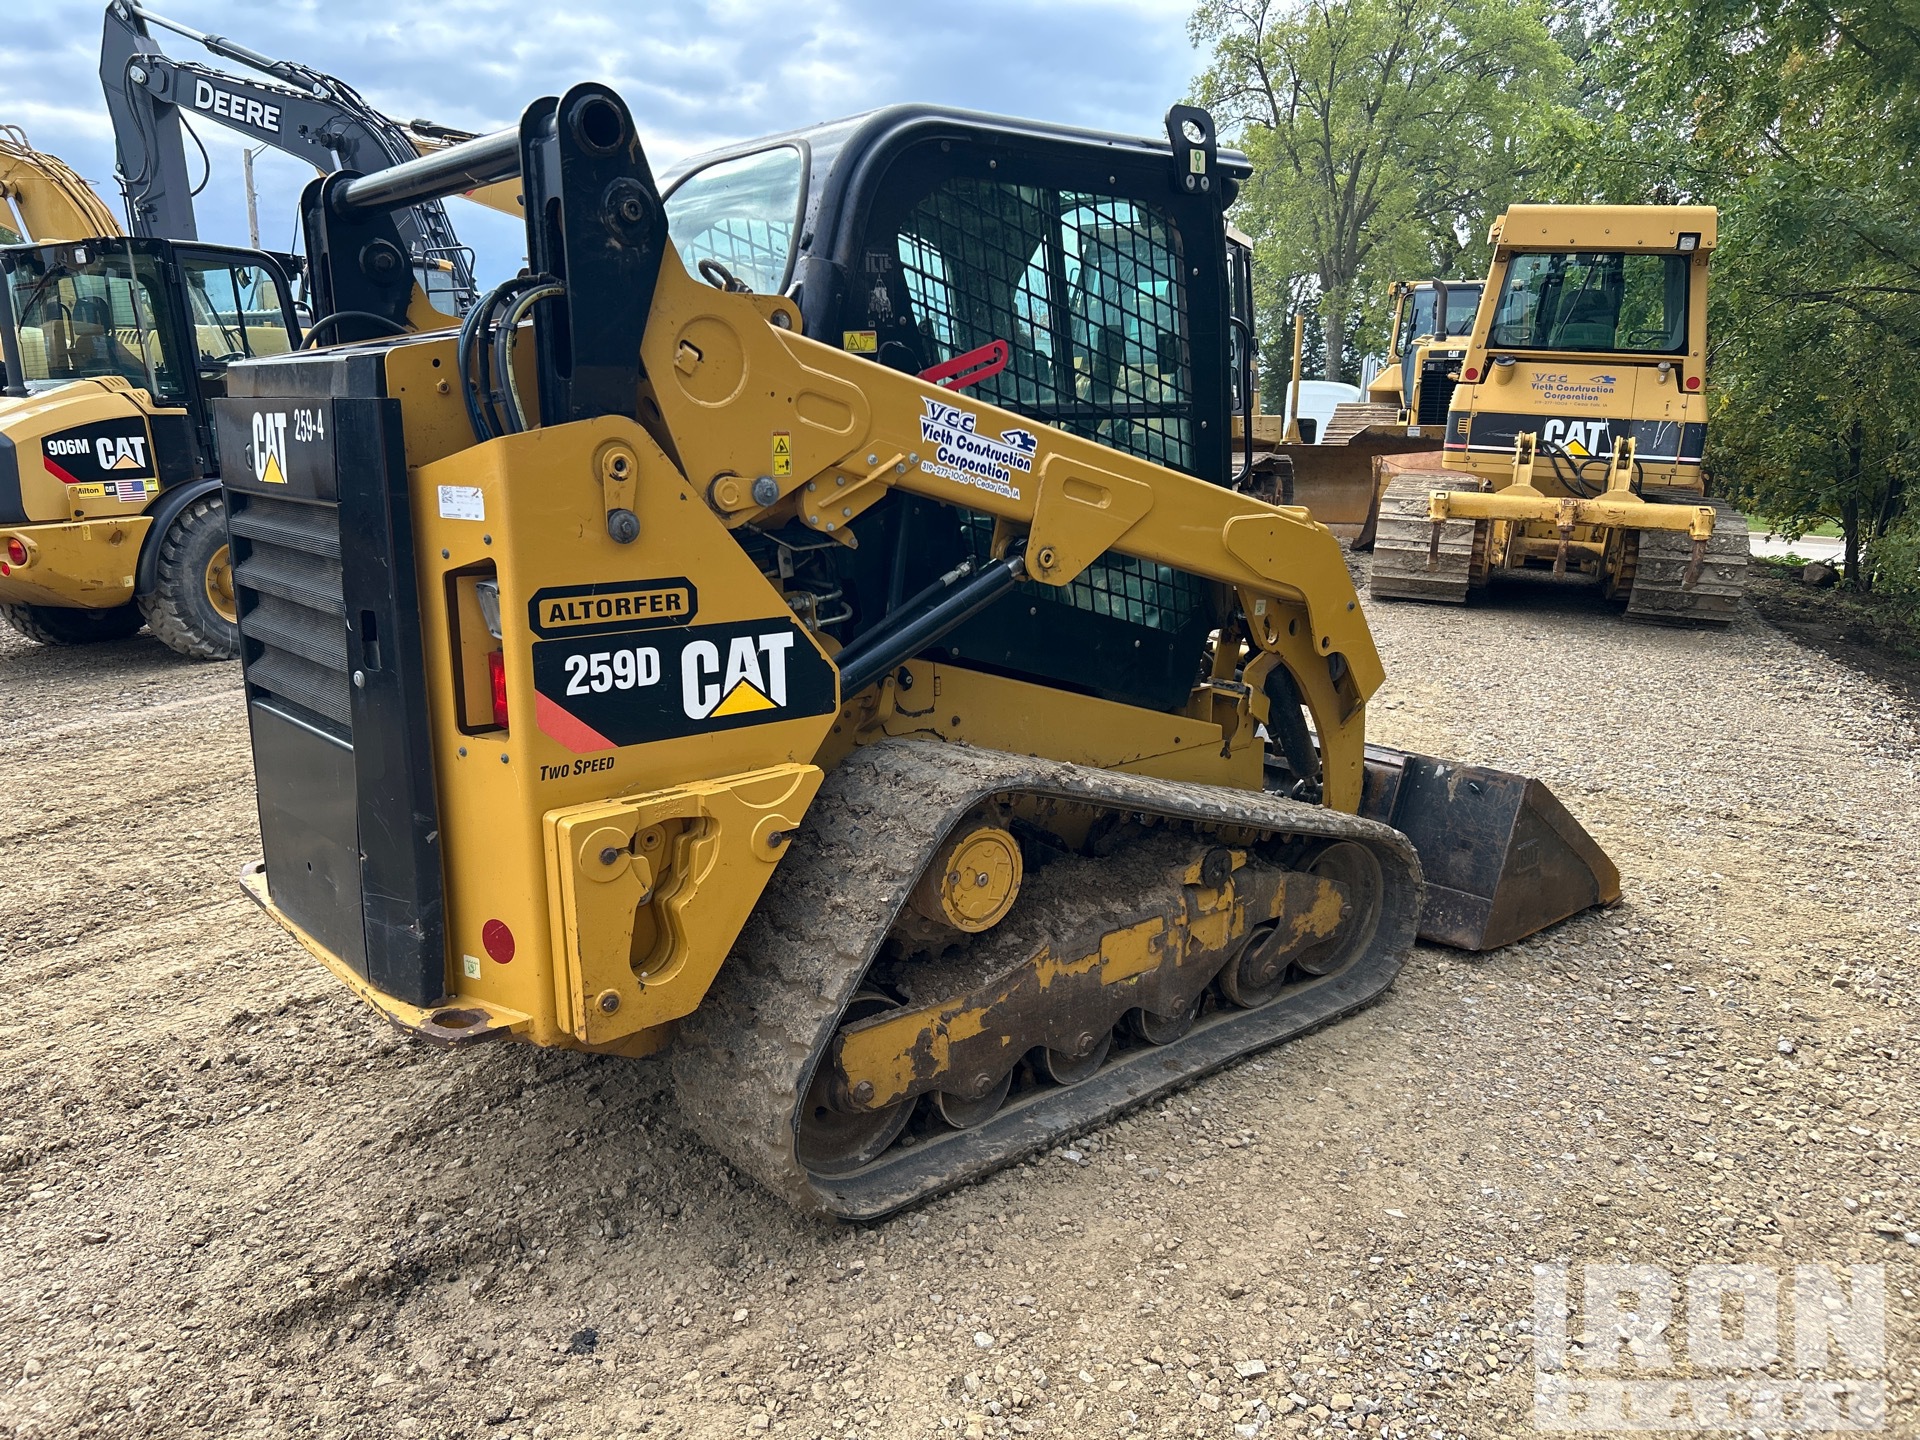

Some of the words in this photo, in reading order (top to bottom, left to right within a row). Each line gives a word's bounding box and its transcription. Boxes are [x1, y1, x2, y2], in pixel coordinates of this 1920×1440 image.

[195, 79, 280, 132] DEERE
[1448, 350, 1460, 358] CAT
[1531, 382, 1553, 391] Vieth
[1556, 384, 1614, 394] Construction
[1544, 391, 1598, 401] Corporation
[925, 399, 975, 433] VCC
[47, 438, 90, 456] 906M
[95, 436, 146, 470] CAT
[252, 411, 288, 484] CAT
[294, 408, 324, 442] 259-4
[922, 421, 953, 446] Vieth
[956, 434, 1031, 471] Construction
[1543, 419, 1606, 457] CAT
[921, 462, 969, 482] 319-277-1006
[976, 478, 996, 490] Cedar
[937, 447, 1010, 482] Corporation
[105, 485, 115, 493] CAT
[549, 593, 682, 623] ALTORFER
[564, 646, 661, 697] 259D
[681, 631, 794, 720] CAT
